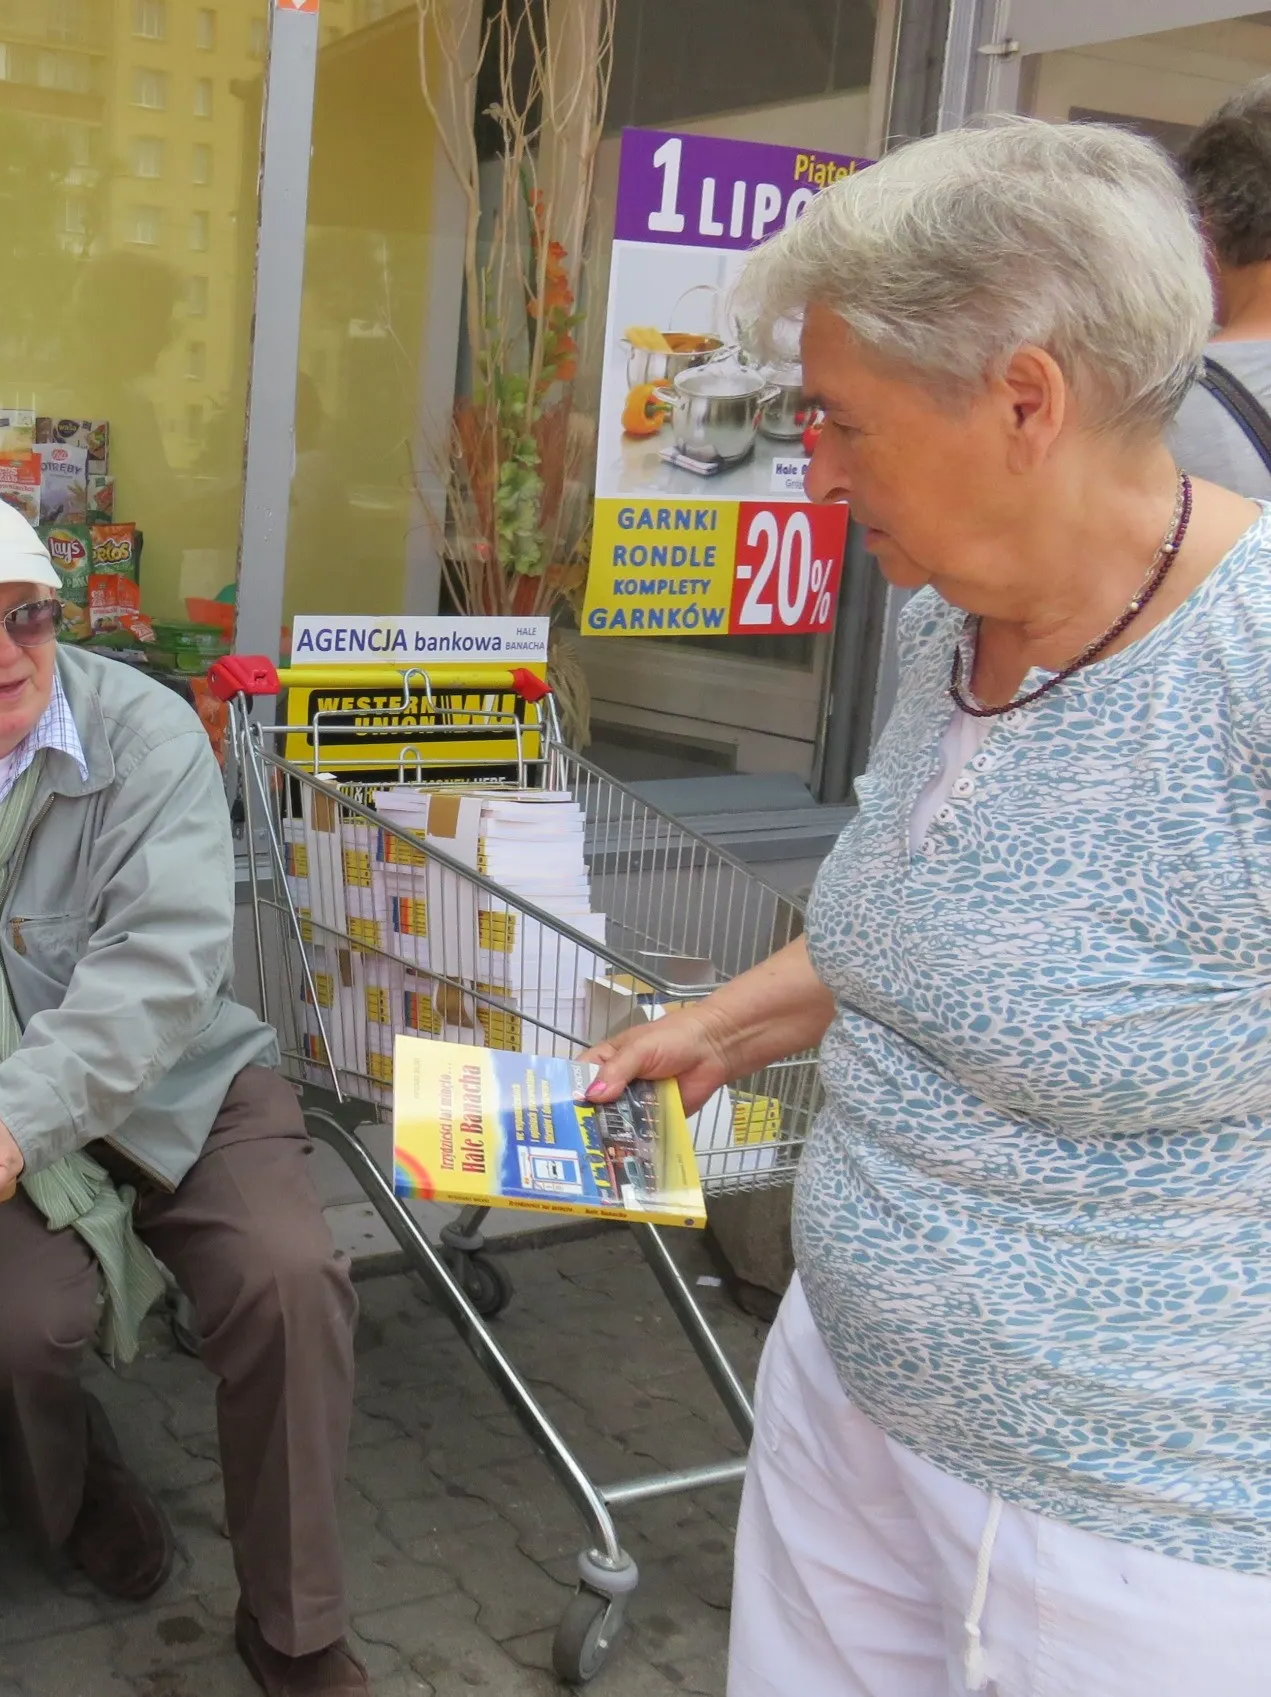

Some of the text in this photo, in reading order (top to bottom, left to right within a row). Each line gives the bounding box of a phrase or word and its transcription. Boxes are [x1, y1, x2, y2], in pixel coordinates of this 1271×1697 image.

[648, 138, 685, 232] 1
[617, 507, 717, 531] GARNKI
[50, 537, 81, 563] Lay's
[612, 544, 716, 567] RONDLE
[736, 511, 834, 627] -20%
[613, 578, 712, 596] KOMPLETY
[588, 602, 726, 630] GARNKÓW
[296, 628, 502, 651] AGENCJA bankowa
[516, 627, 537, 636] HALE
[505, 641, 545, 650] BANACHA
[317, 695, 437, 715] WESTERN
[354, 716, 436, 736] UNION
[458, 1065, 484, 1135] Banacha
[460, 1139, 486, 1174] Hale
